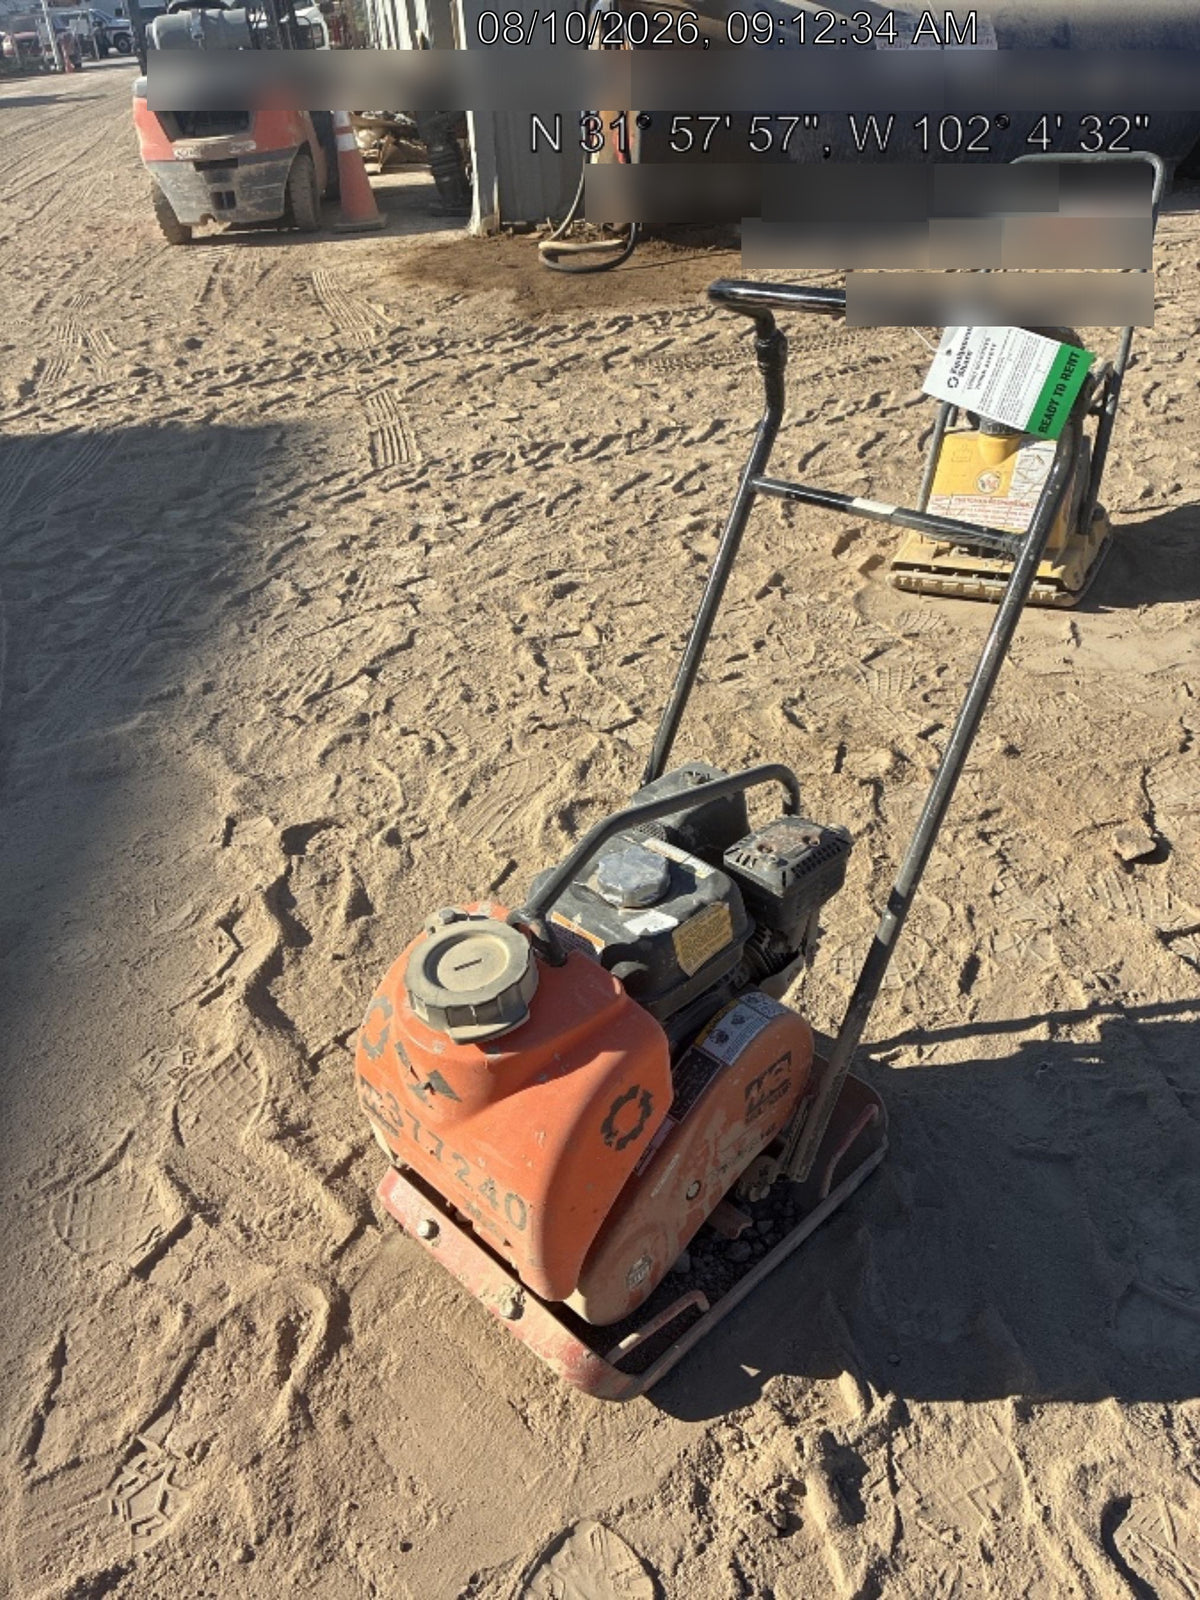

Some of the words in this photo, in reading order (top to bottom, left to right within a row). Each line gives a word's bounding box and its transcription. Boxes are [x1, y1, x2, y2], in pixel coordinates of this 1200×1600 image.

[1060, 351, 1081, 383] RENT
[1053, 383, 1068, 398] TO
[1037, 400, 1060, 434] READY
